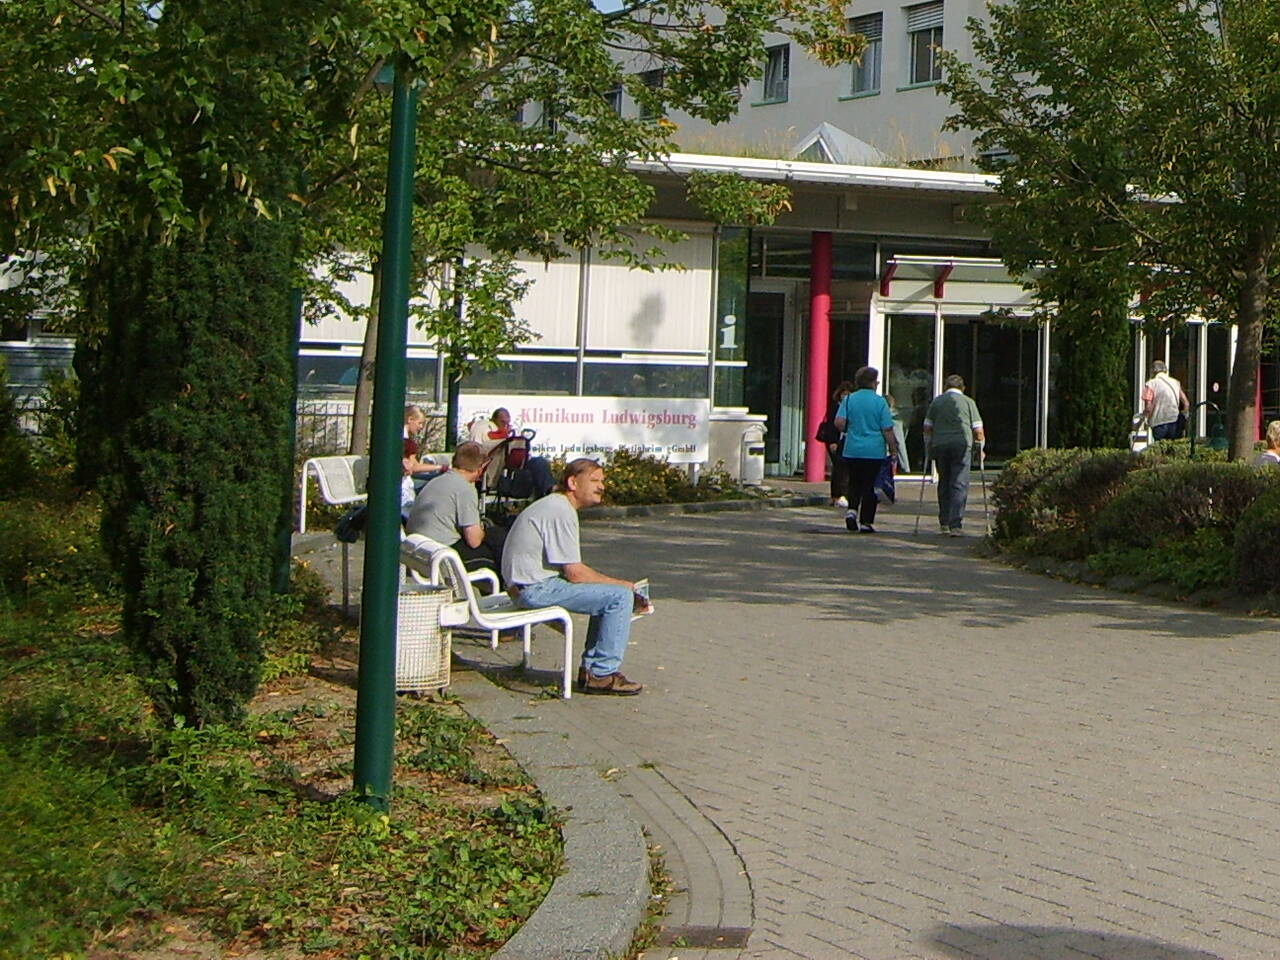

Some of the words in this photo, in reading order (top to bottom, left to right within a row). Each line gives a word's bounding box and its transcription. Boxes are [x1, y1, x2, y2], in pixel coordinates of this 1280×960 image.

[720, 314, 738, 349] i
[521, 407, 594, 424] Klinikum
[602, 409, 697, 429] Ludwigsburg
